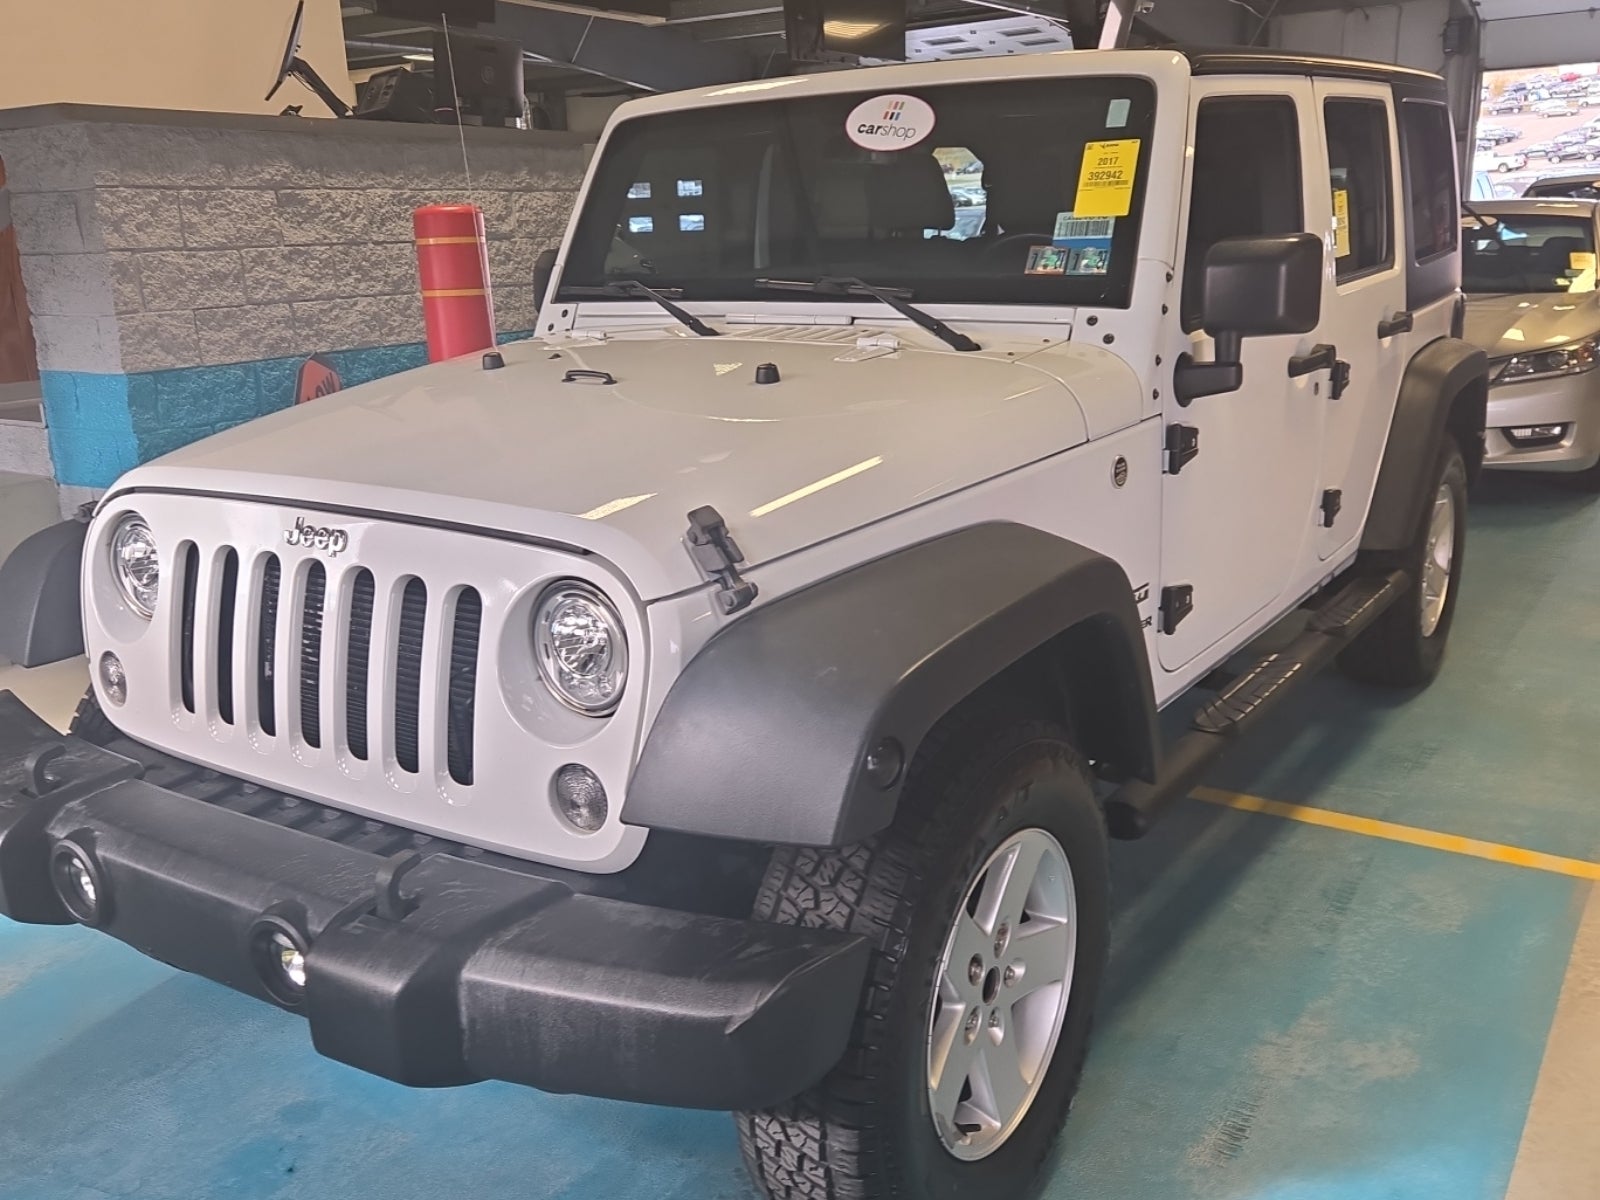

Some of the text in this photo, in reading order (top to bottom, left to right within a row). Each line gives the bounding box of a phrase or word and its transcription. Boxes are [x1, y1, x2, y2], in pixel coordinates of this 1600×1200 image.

[857, 123, 916, 141] carshop
[1097, 156, 1120, 166] 2017
[1087, 170, 1123, 181] 392942
[283, 516, 348, 558] Jeep
